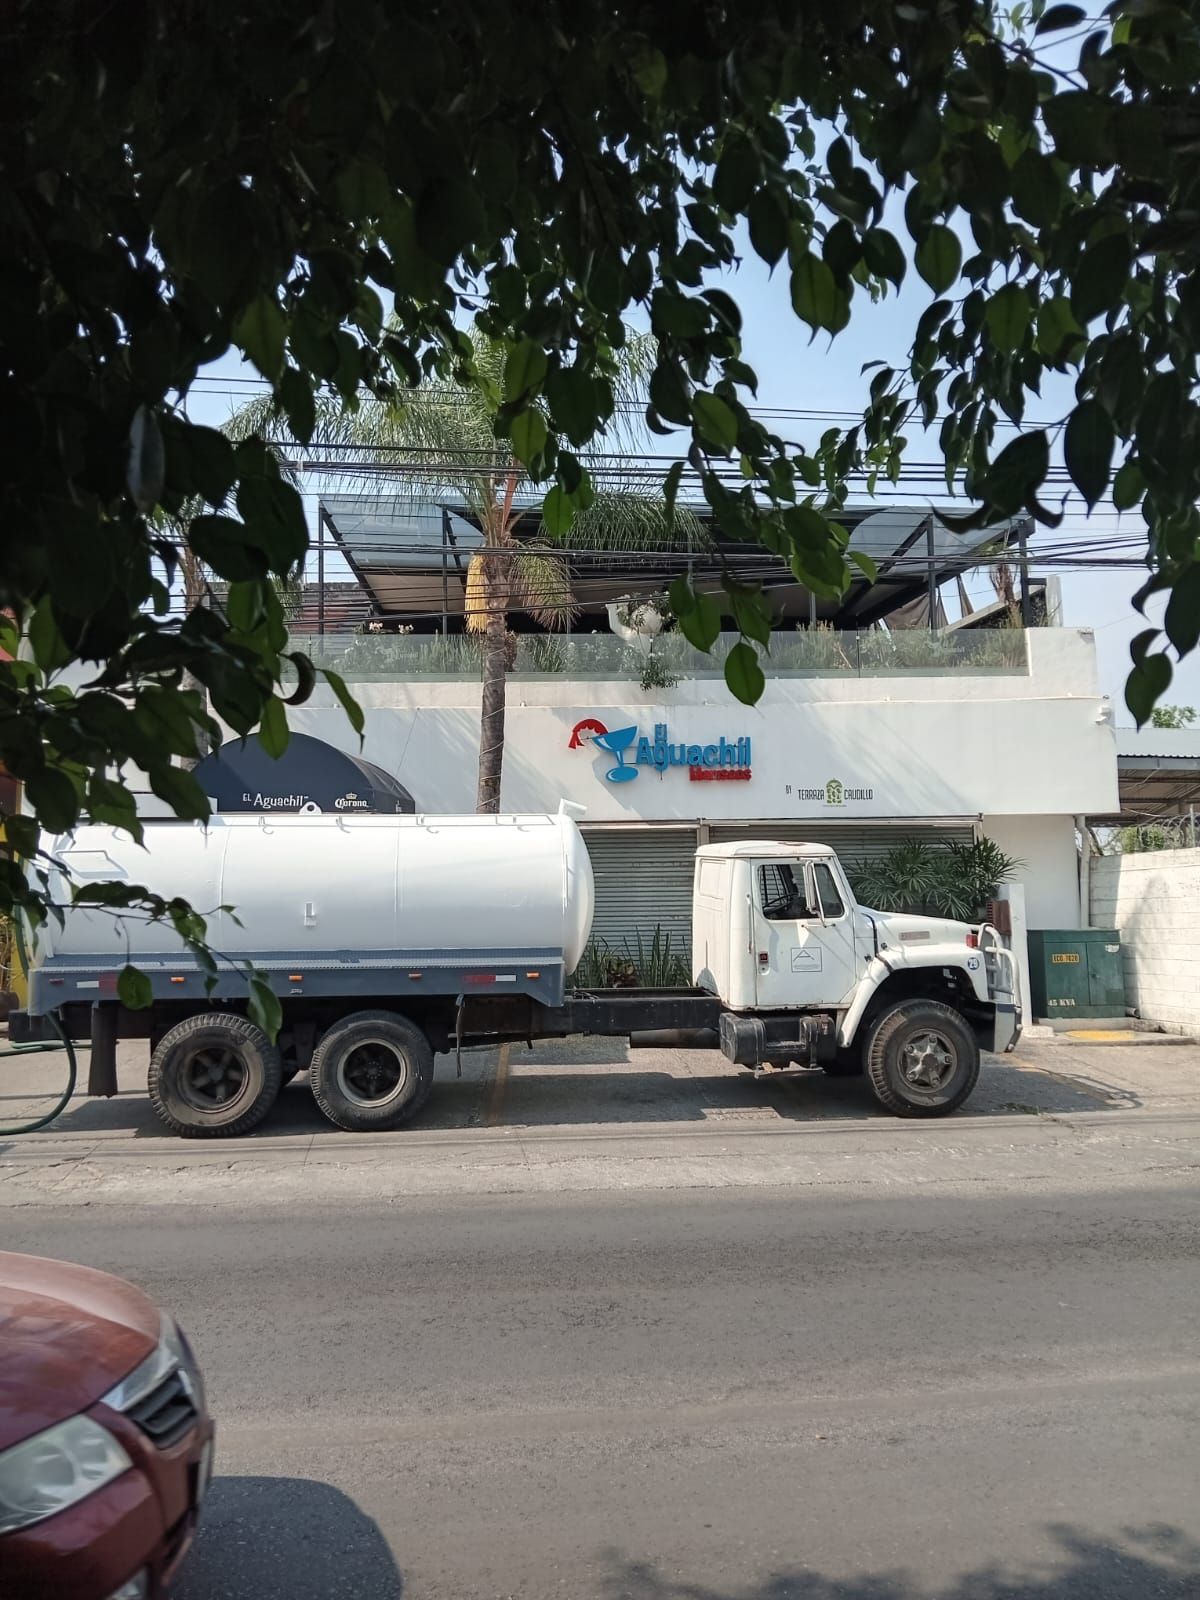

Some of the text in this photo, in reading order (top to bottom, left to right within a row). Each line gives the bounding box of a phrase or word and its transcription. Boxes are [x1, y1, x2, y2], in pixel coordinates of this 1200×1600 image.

[636, 736, 751, 771] Aguachil
[242, 793, 303, 809] EL Aguachil
[798, 789, 825, 801] TERRAZA
[843, 789, 874, 801] CAUDILLO
[335, 798, 368, 809] Corona
